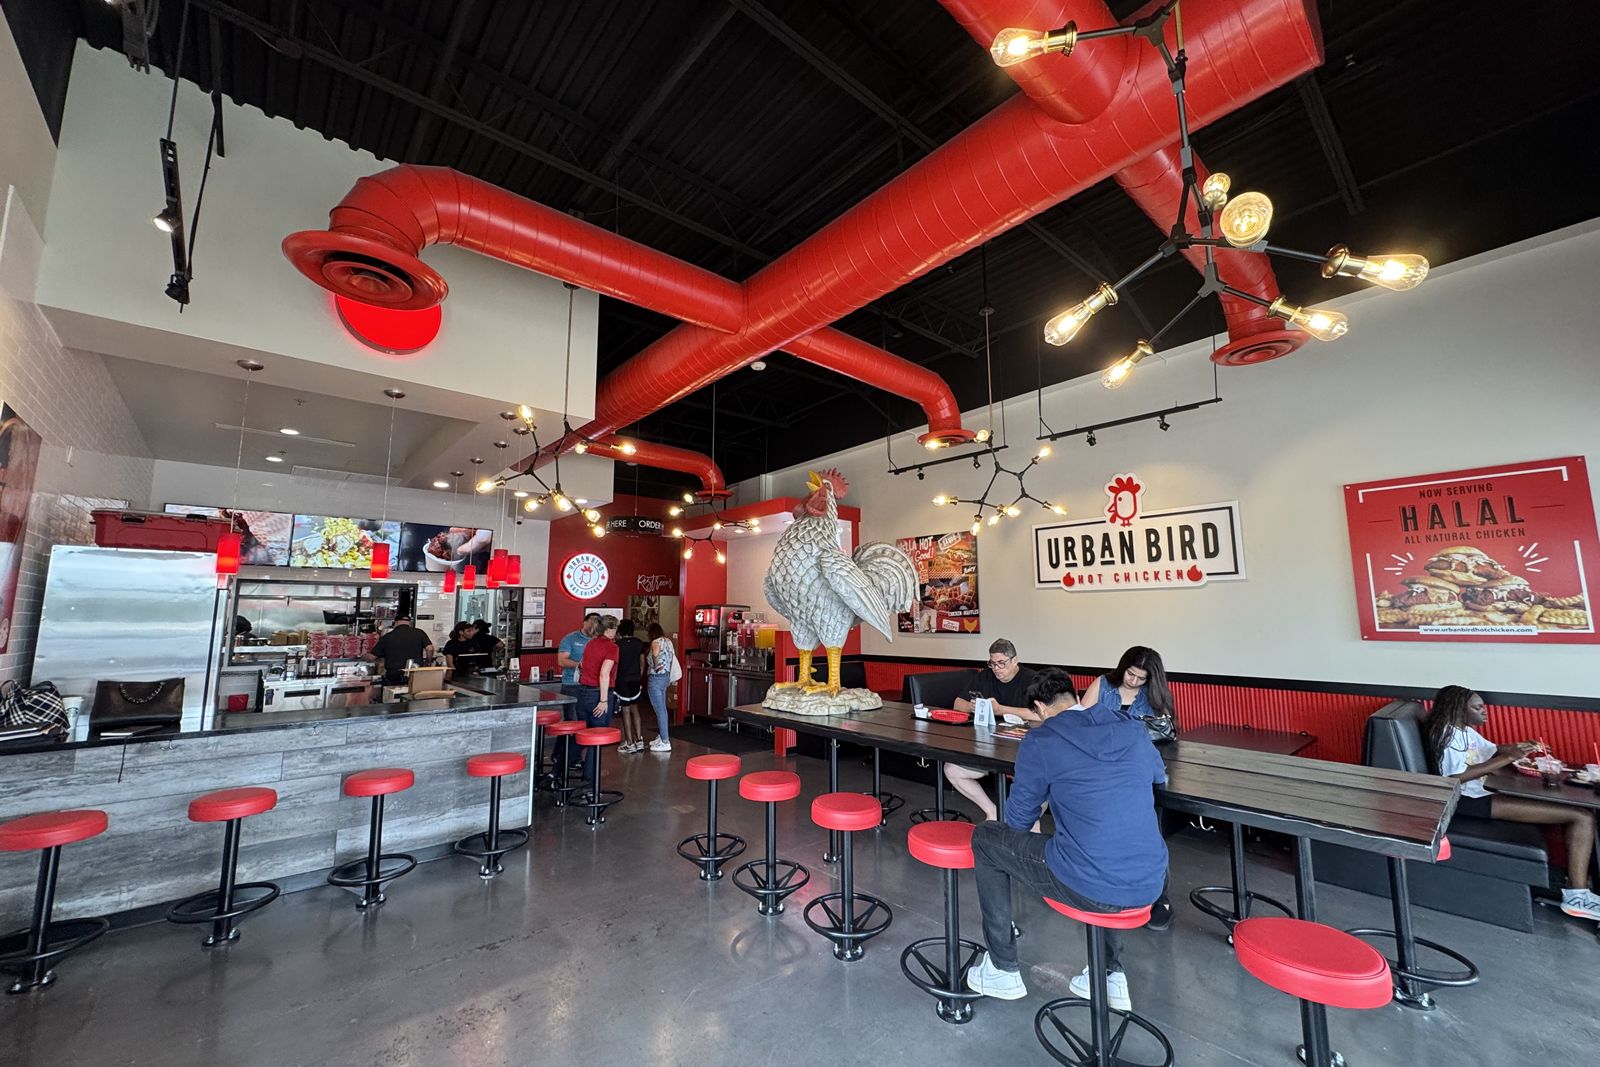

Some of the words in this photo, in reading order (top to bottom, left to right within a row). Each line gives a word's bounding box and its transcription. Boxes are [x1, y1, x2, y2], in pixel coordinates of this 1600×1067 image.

[1419, 488, 1442, 499] NOW
[1447, 483, 1493, 496] SERVING
[1399, 495, 1525, 532] HALAL
[610, 519, 627, 528] HERE
[920, 535, 934, 551] HOT
[1404, 534, 1421, 545] ALL
[1425, 531, 1471, 544] NATURAL
[1476, 527, 1526, 540] CHICKEN
[1047, 530, 1136, 569] URBAN
[1145, 522, 1220, 563] BIRD
[568, 555, 590, 570] URBAN
[590, 557, 605, 571] BIRD
[1078, 573, 1103, 585] HOT
[1113, 569, 1184, 584] CHICKEN
[580, 584, 603, 596] CHICKEN
